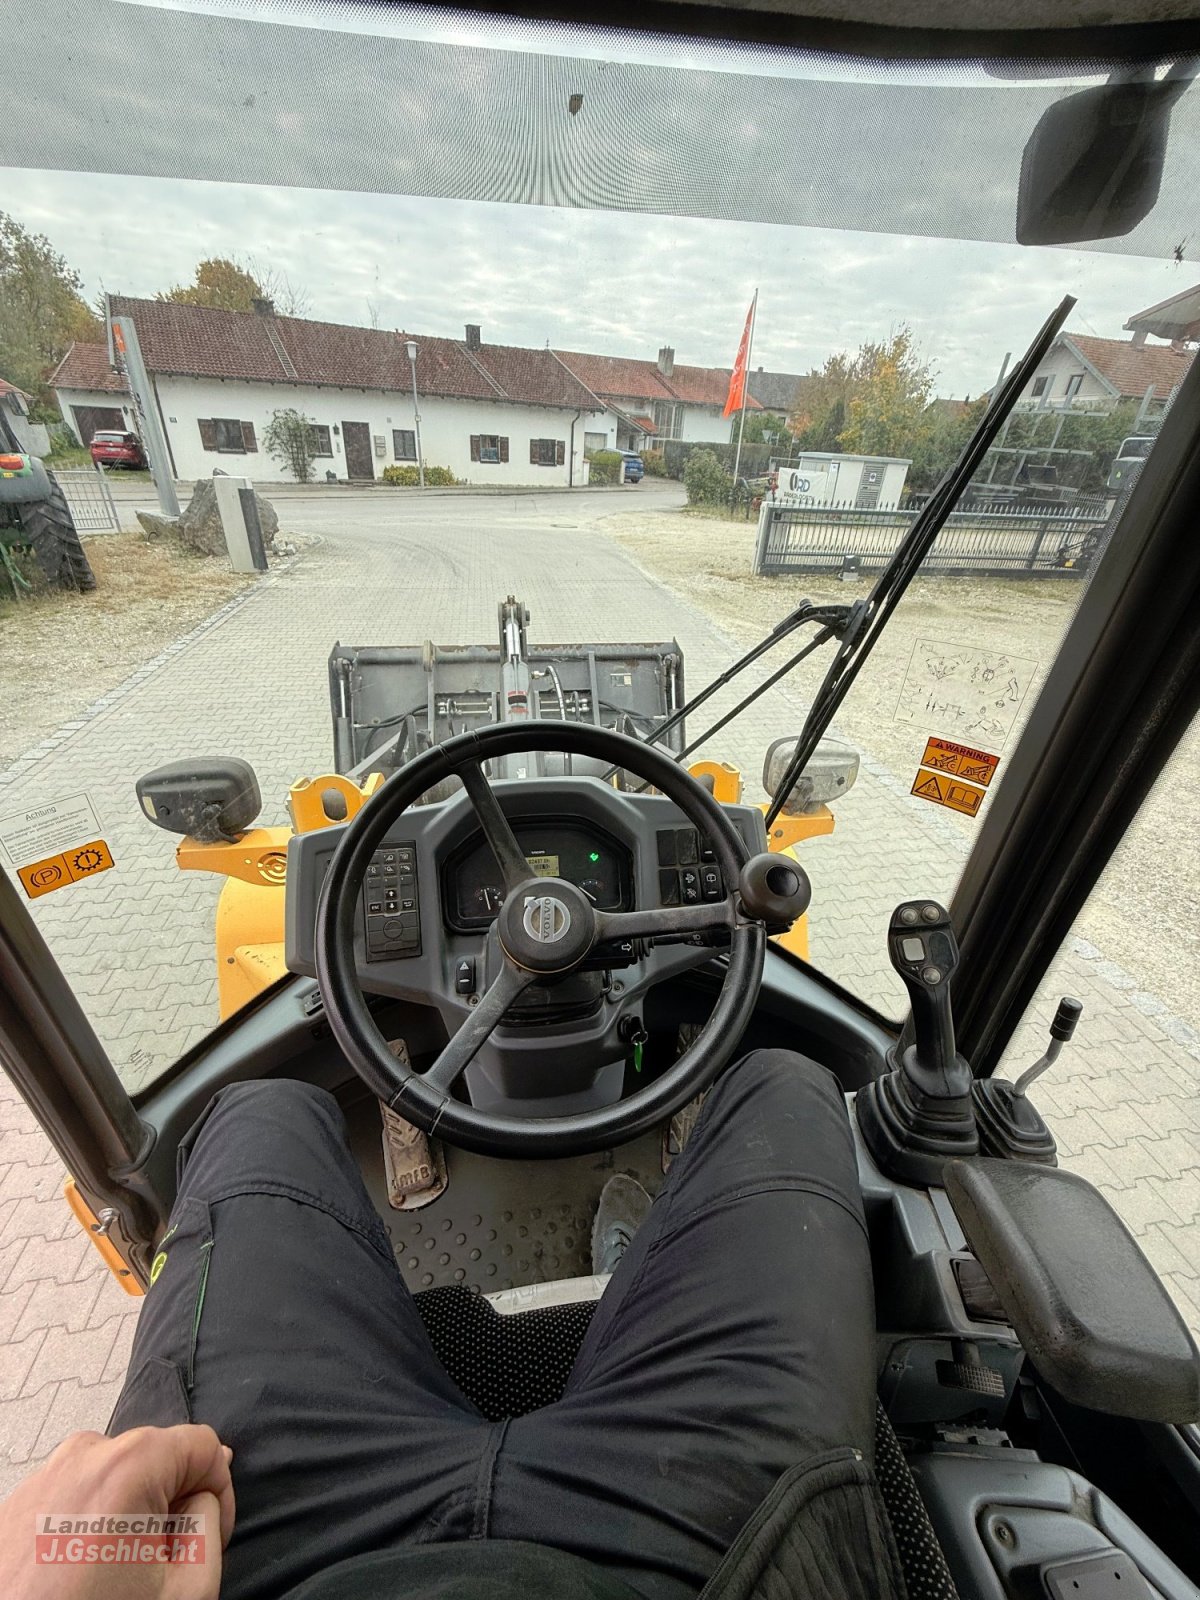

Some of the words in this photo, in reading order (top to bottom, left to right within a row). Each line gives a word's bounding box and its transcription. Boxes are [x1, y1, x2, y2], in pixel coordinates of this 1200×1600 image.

[945, 743, 990, 763] WARNING
[25, 806, 57, 821] Achtung
[542, 897, 552, 940] VOLVO
